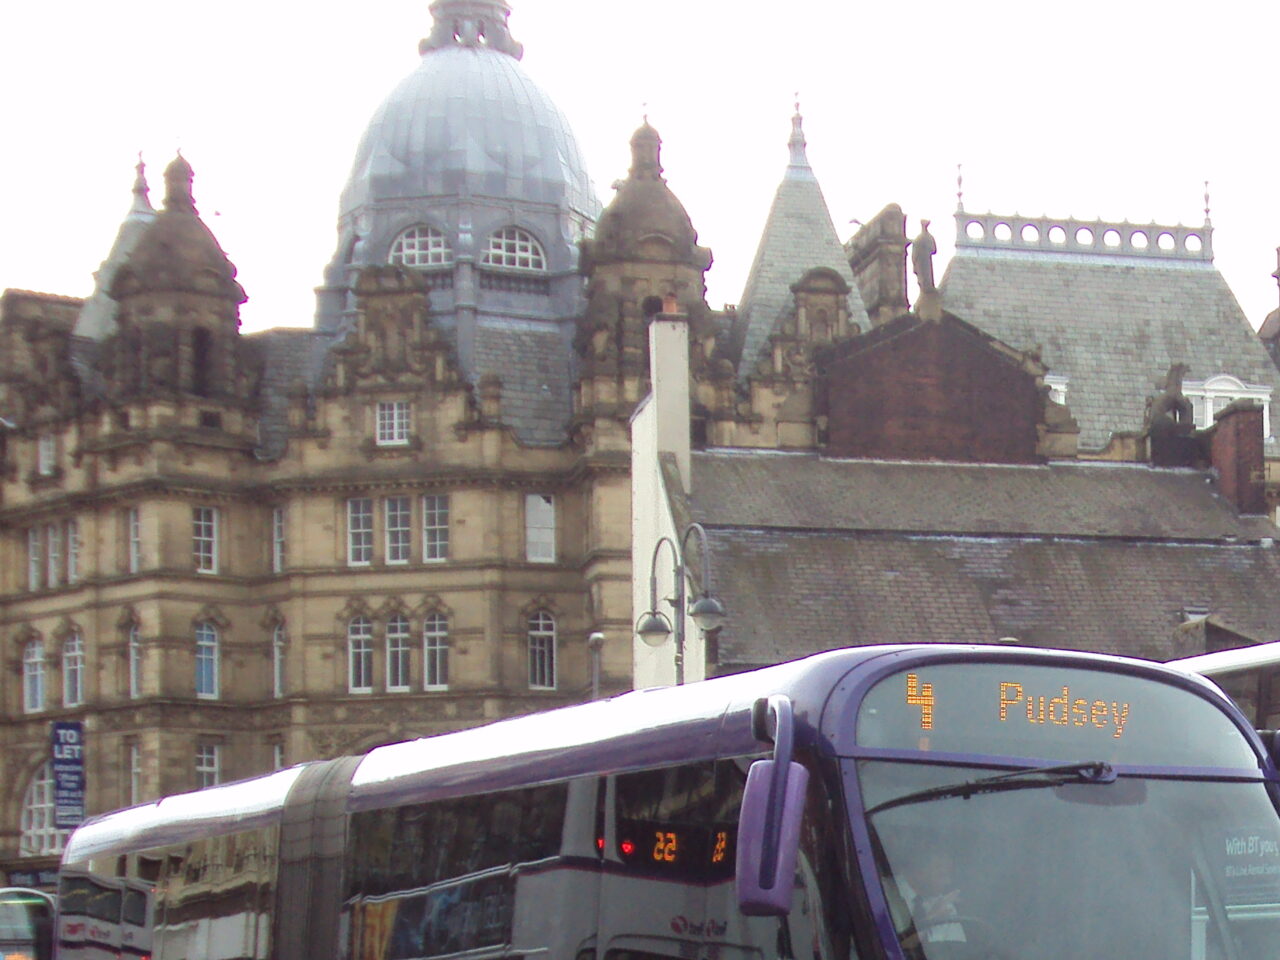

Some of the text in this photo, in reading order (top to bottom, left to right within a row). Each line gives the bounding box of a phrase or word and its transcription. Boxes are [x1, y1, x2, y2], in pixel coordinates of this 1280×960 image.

[907, 673, 1129, 738] 4 Pudsey
[57, 729, 77, 743] TO
[54, 744, 82, 759] LET
[1225, 837, 1246, 855] With
[1248, 835, 1260, 854] BT
